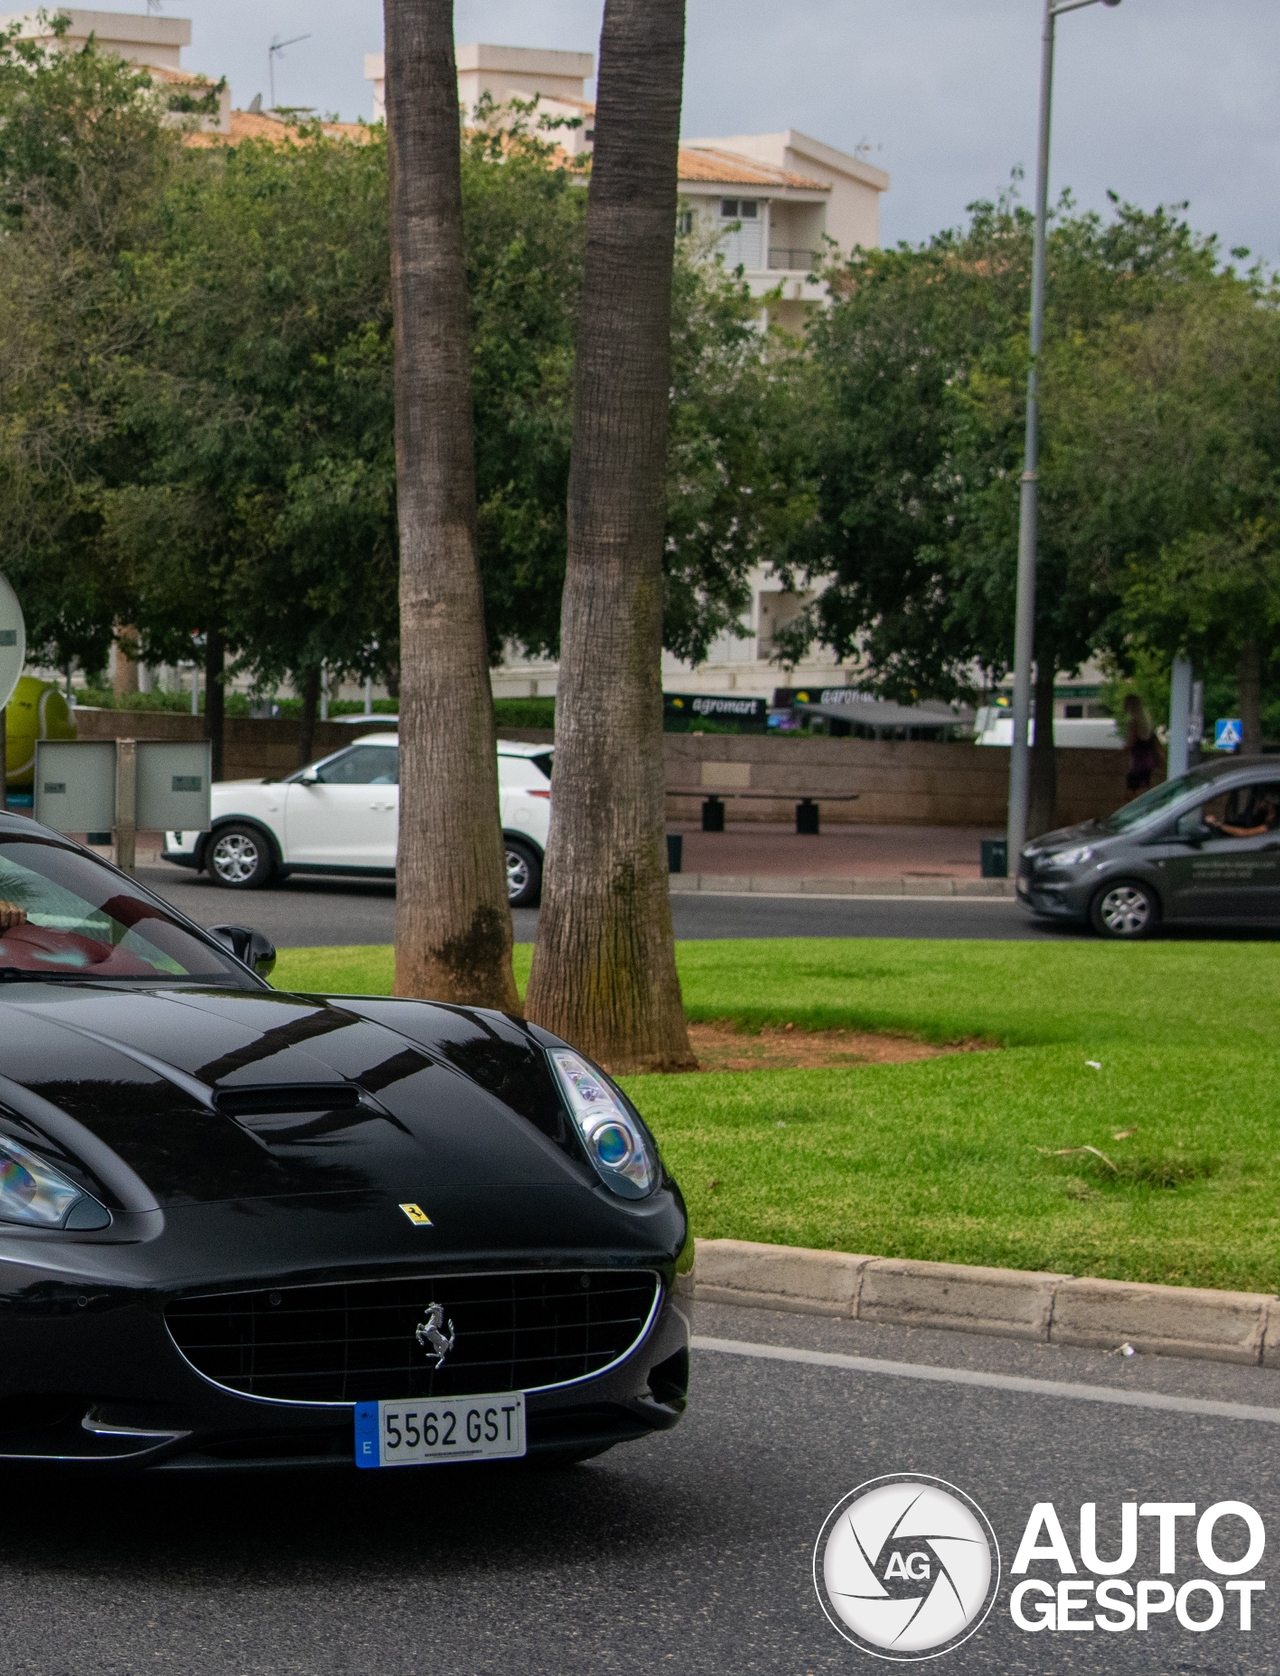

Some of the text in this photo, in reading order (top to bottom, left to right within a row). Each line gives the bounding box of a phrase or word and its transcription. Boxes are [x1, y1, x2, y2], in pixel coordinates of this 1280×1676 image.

[692, 698, 758, 716] agromart
[363, 1406, 516, 1454] E 5562 GST
